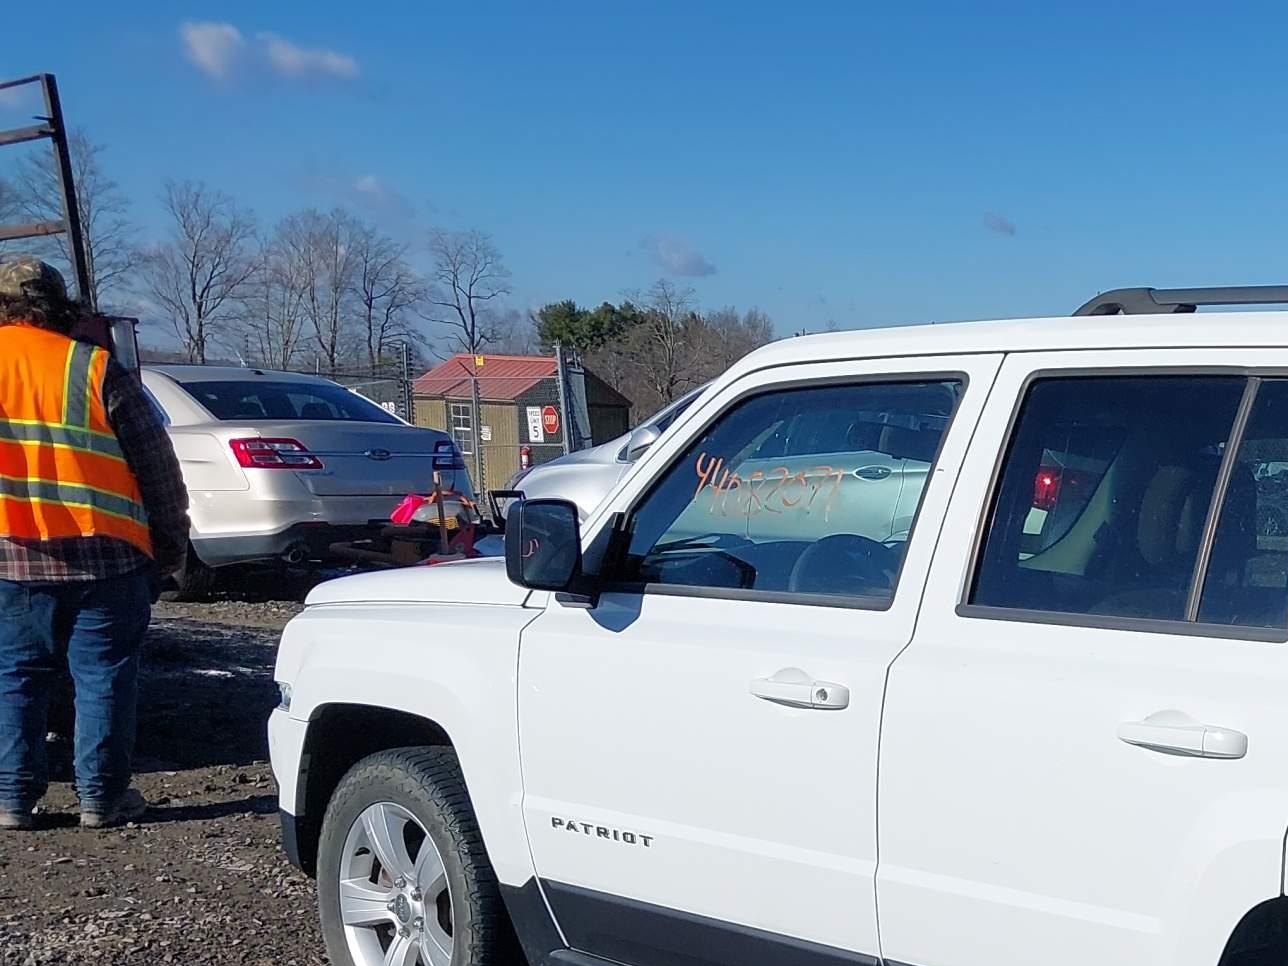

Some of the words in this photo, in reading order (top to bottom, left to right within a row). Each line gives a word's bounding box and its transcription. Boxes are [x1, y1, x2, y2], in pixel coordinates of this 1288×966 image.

[544, 414, 557, 425] STOP
[533, 425, 540, 438] 5
[551, 816, 654, 848] PATRIOT
